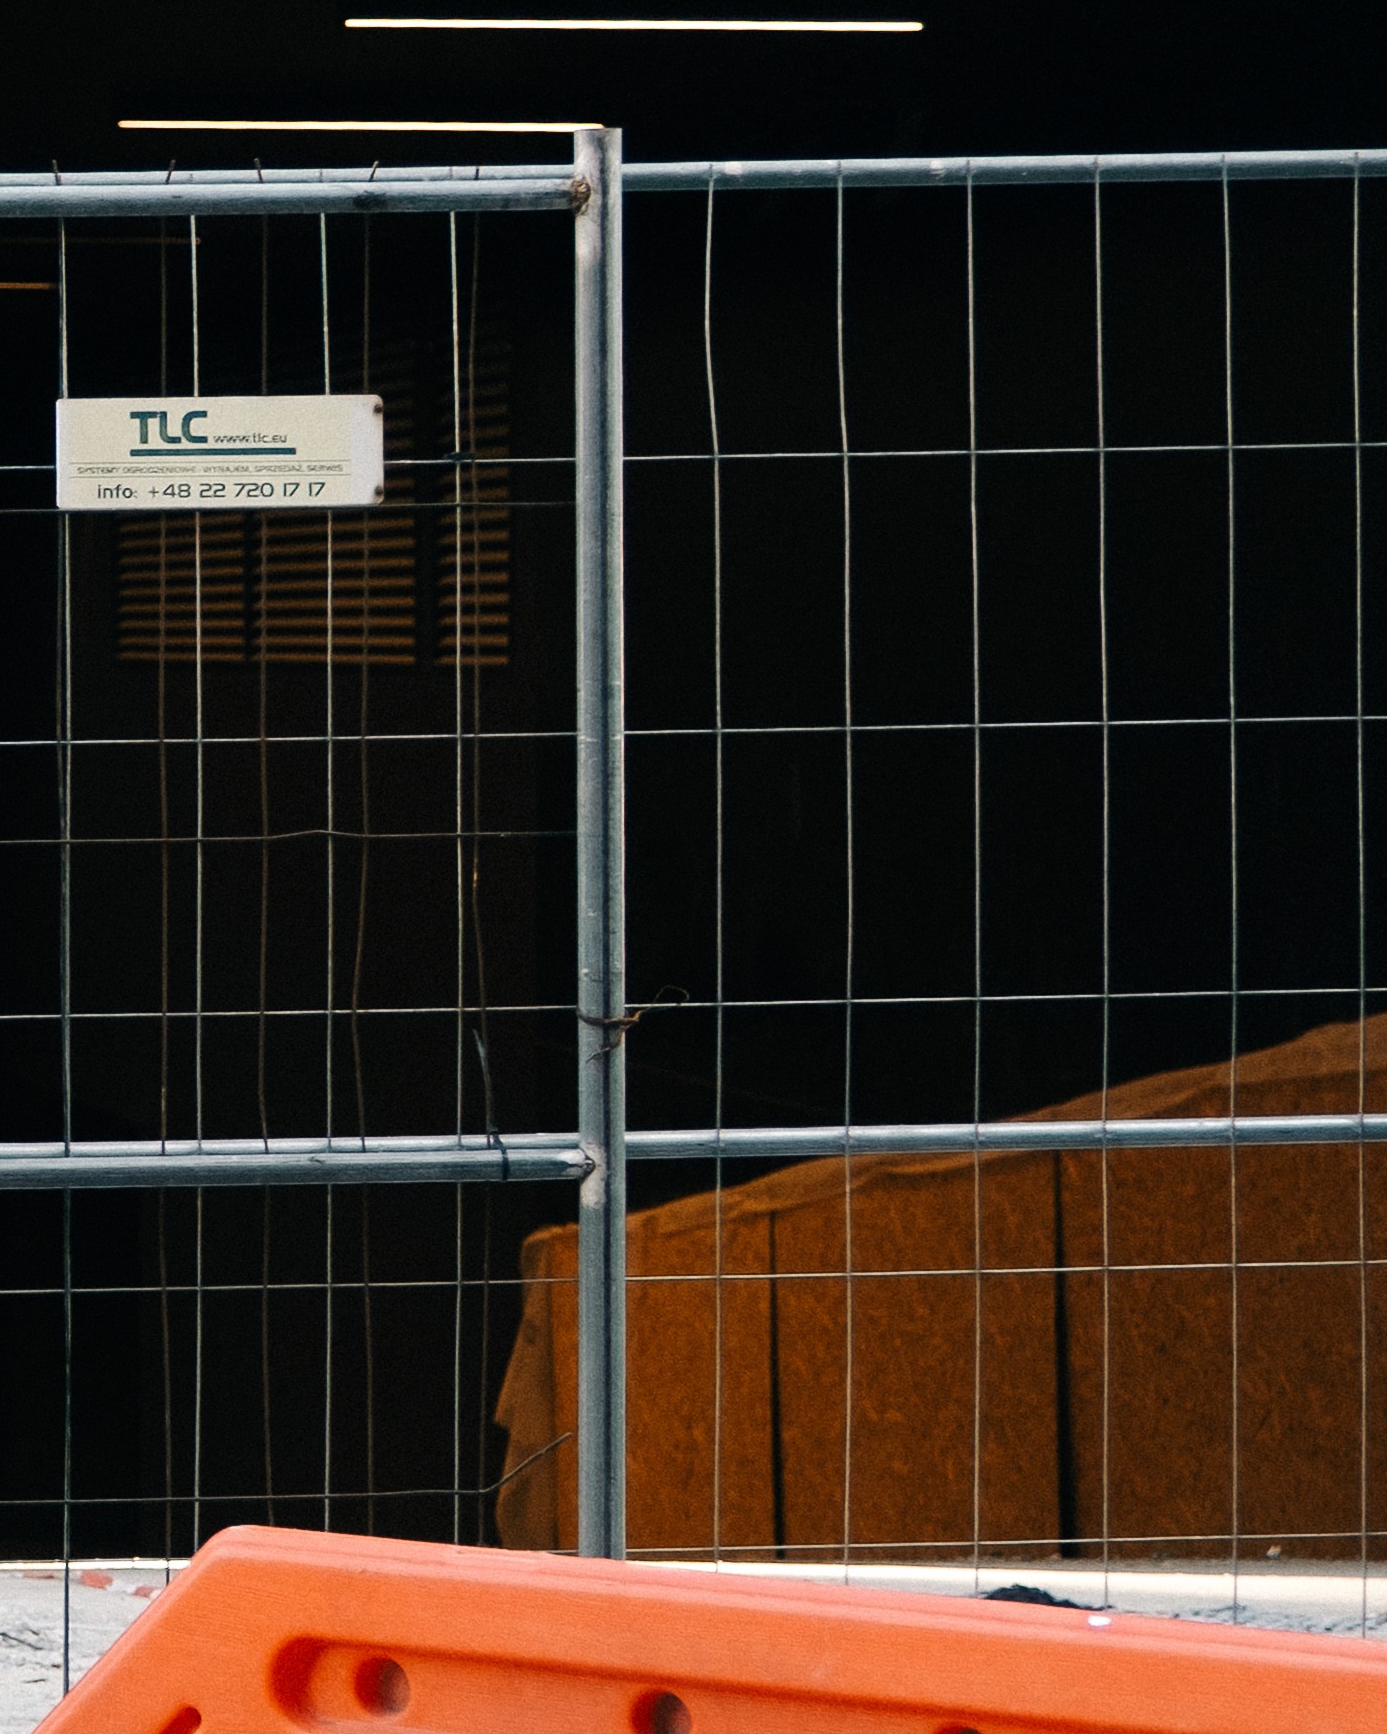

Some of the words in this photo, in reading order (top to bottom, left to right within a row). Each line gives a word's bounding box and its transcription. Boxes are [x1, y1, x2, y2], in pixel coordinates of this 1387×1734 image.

[130, 410, 208, 444] TLC
[213, 433, 287, 444] www.tlc.eu
[97, 484, 138, 499] info:
[149, 483, 191, 498] +48
[199, 483, 226, 498] 22
[233, 482, 274, 498] 720
[283, 482, 300, 498] 17
[308, 482, 326, 497] 17
